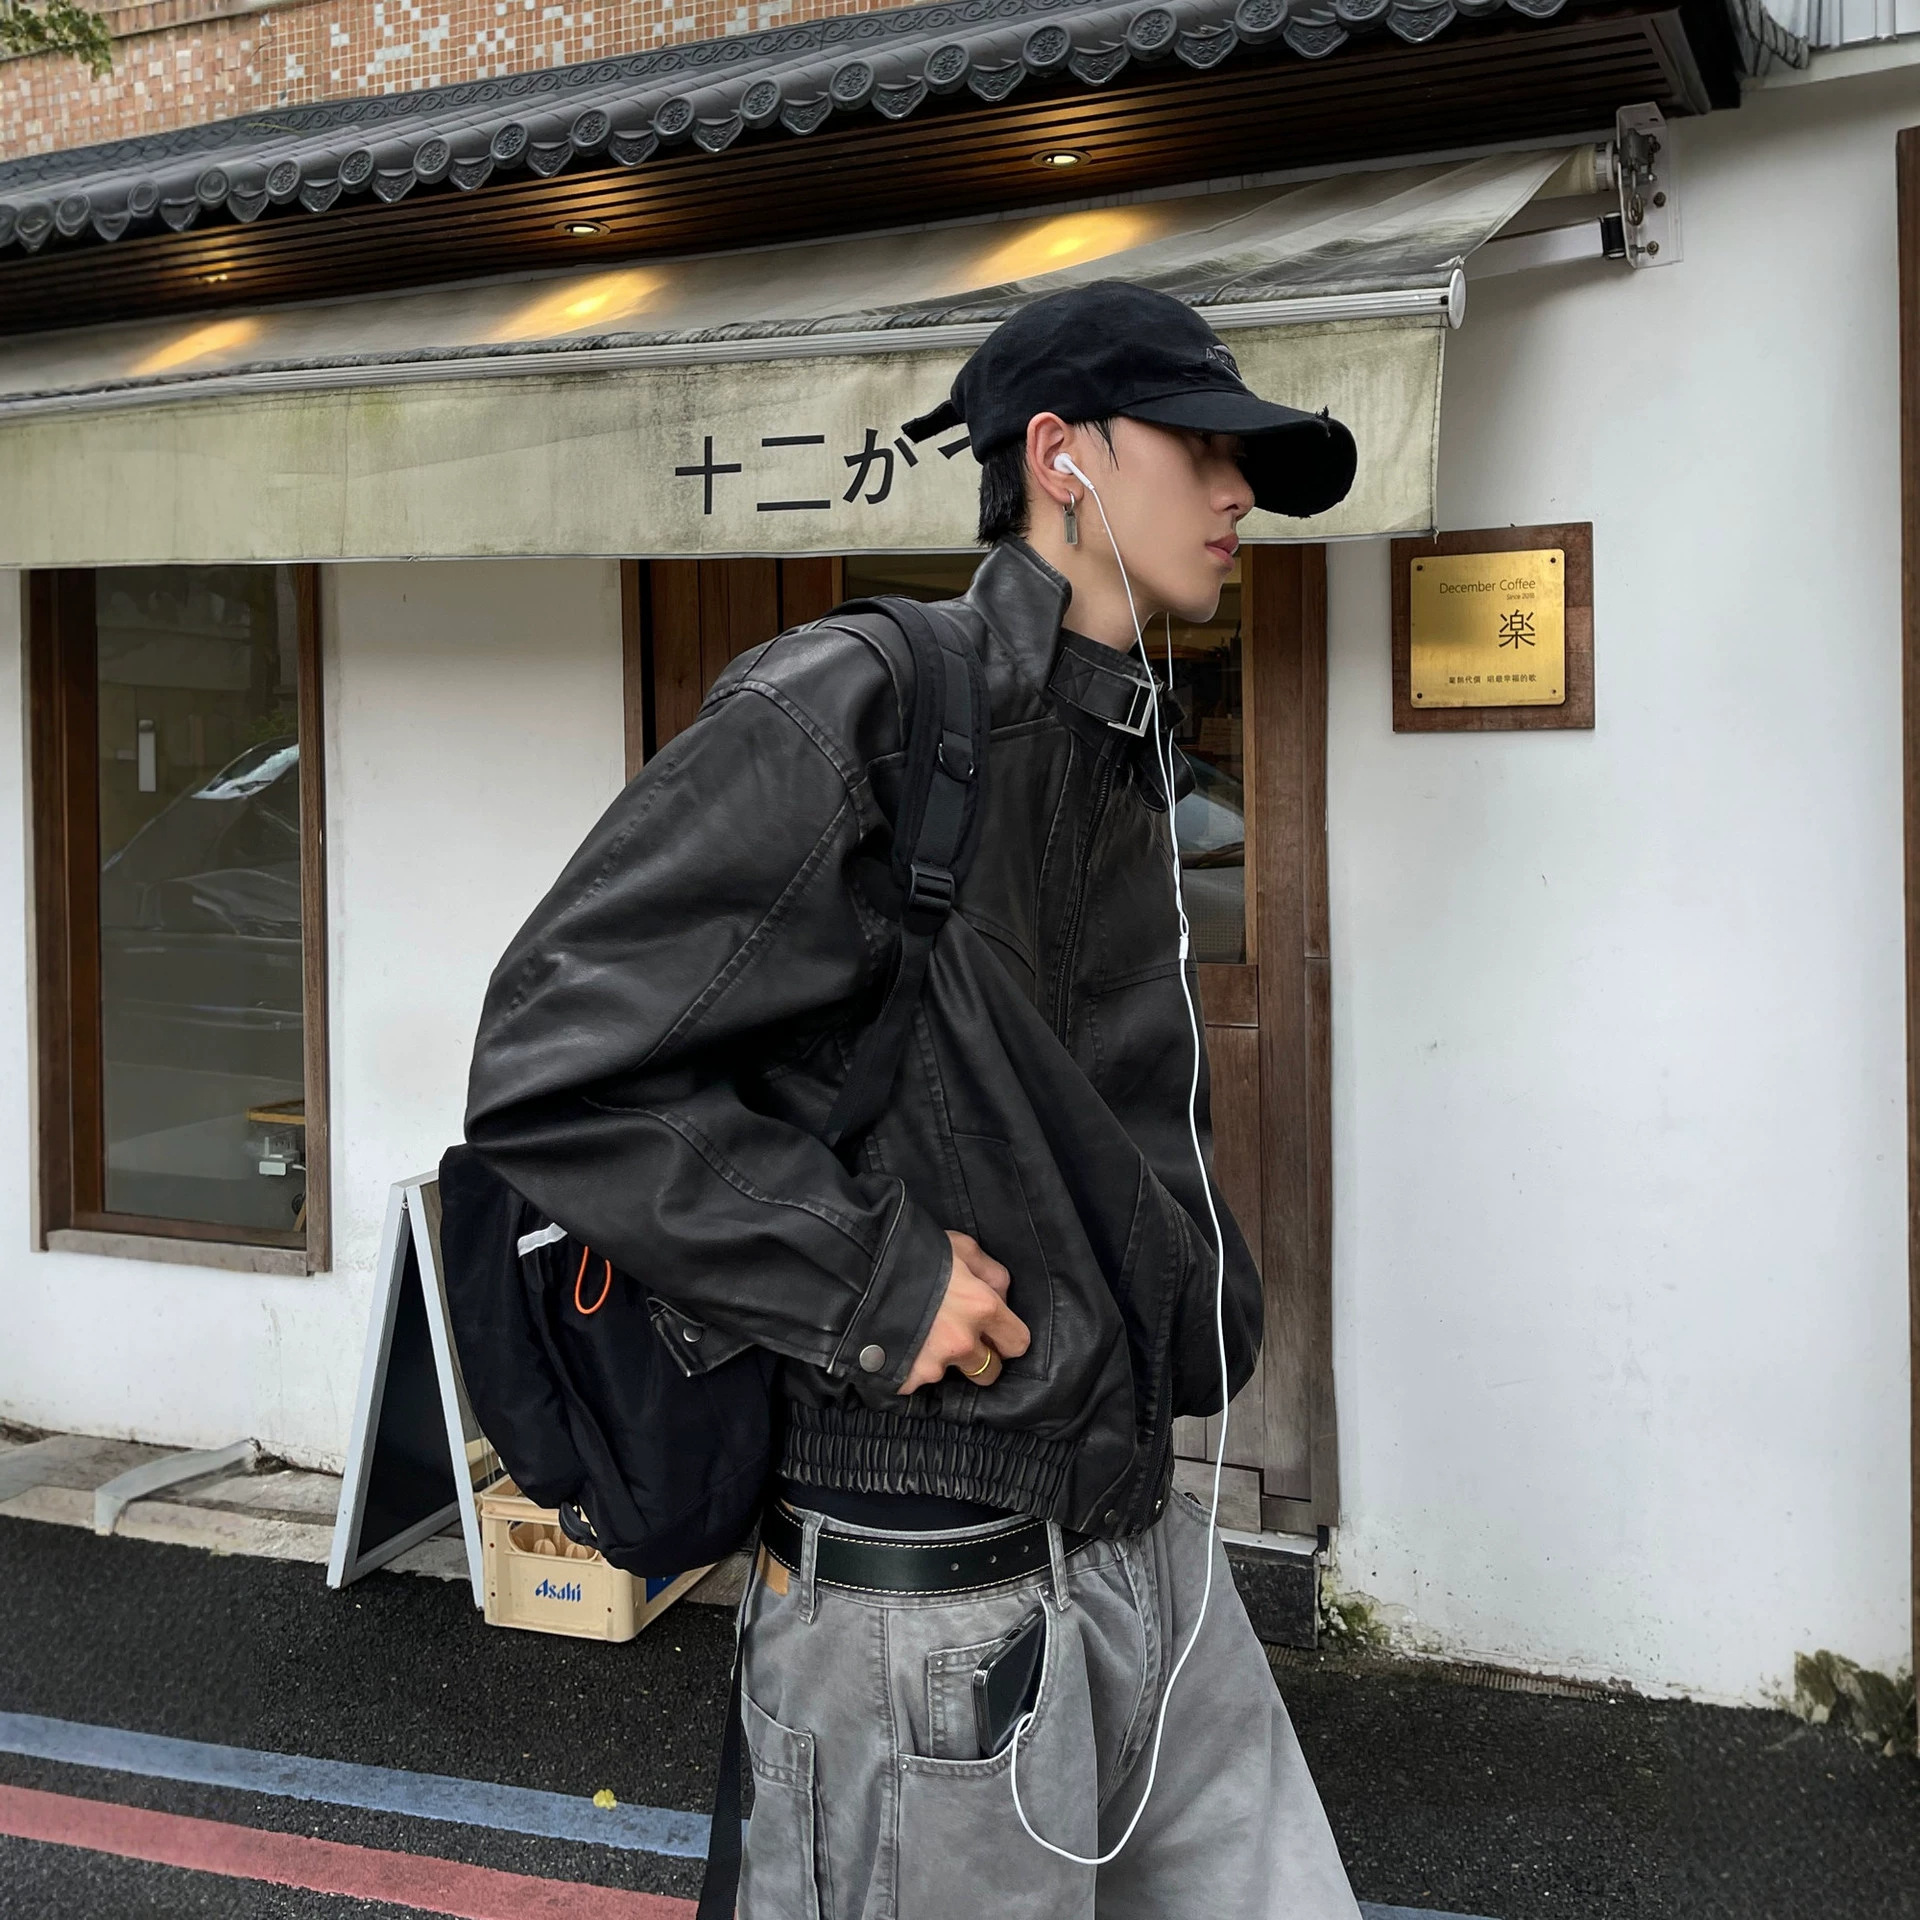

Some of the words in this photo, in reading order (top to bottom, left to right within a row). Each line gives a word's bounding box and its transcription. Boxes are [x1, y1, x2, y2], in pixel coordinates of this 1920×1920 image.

[675, 428, 971, 515] 十二が
[1439, 580, 1496, 594] December
[1499, 578, 1536, 591] Coffee
[1498, 609, 1536, 649] 楽
[535, 1578, 581, 1602] Asahi
